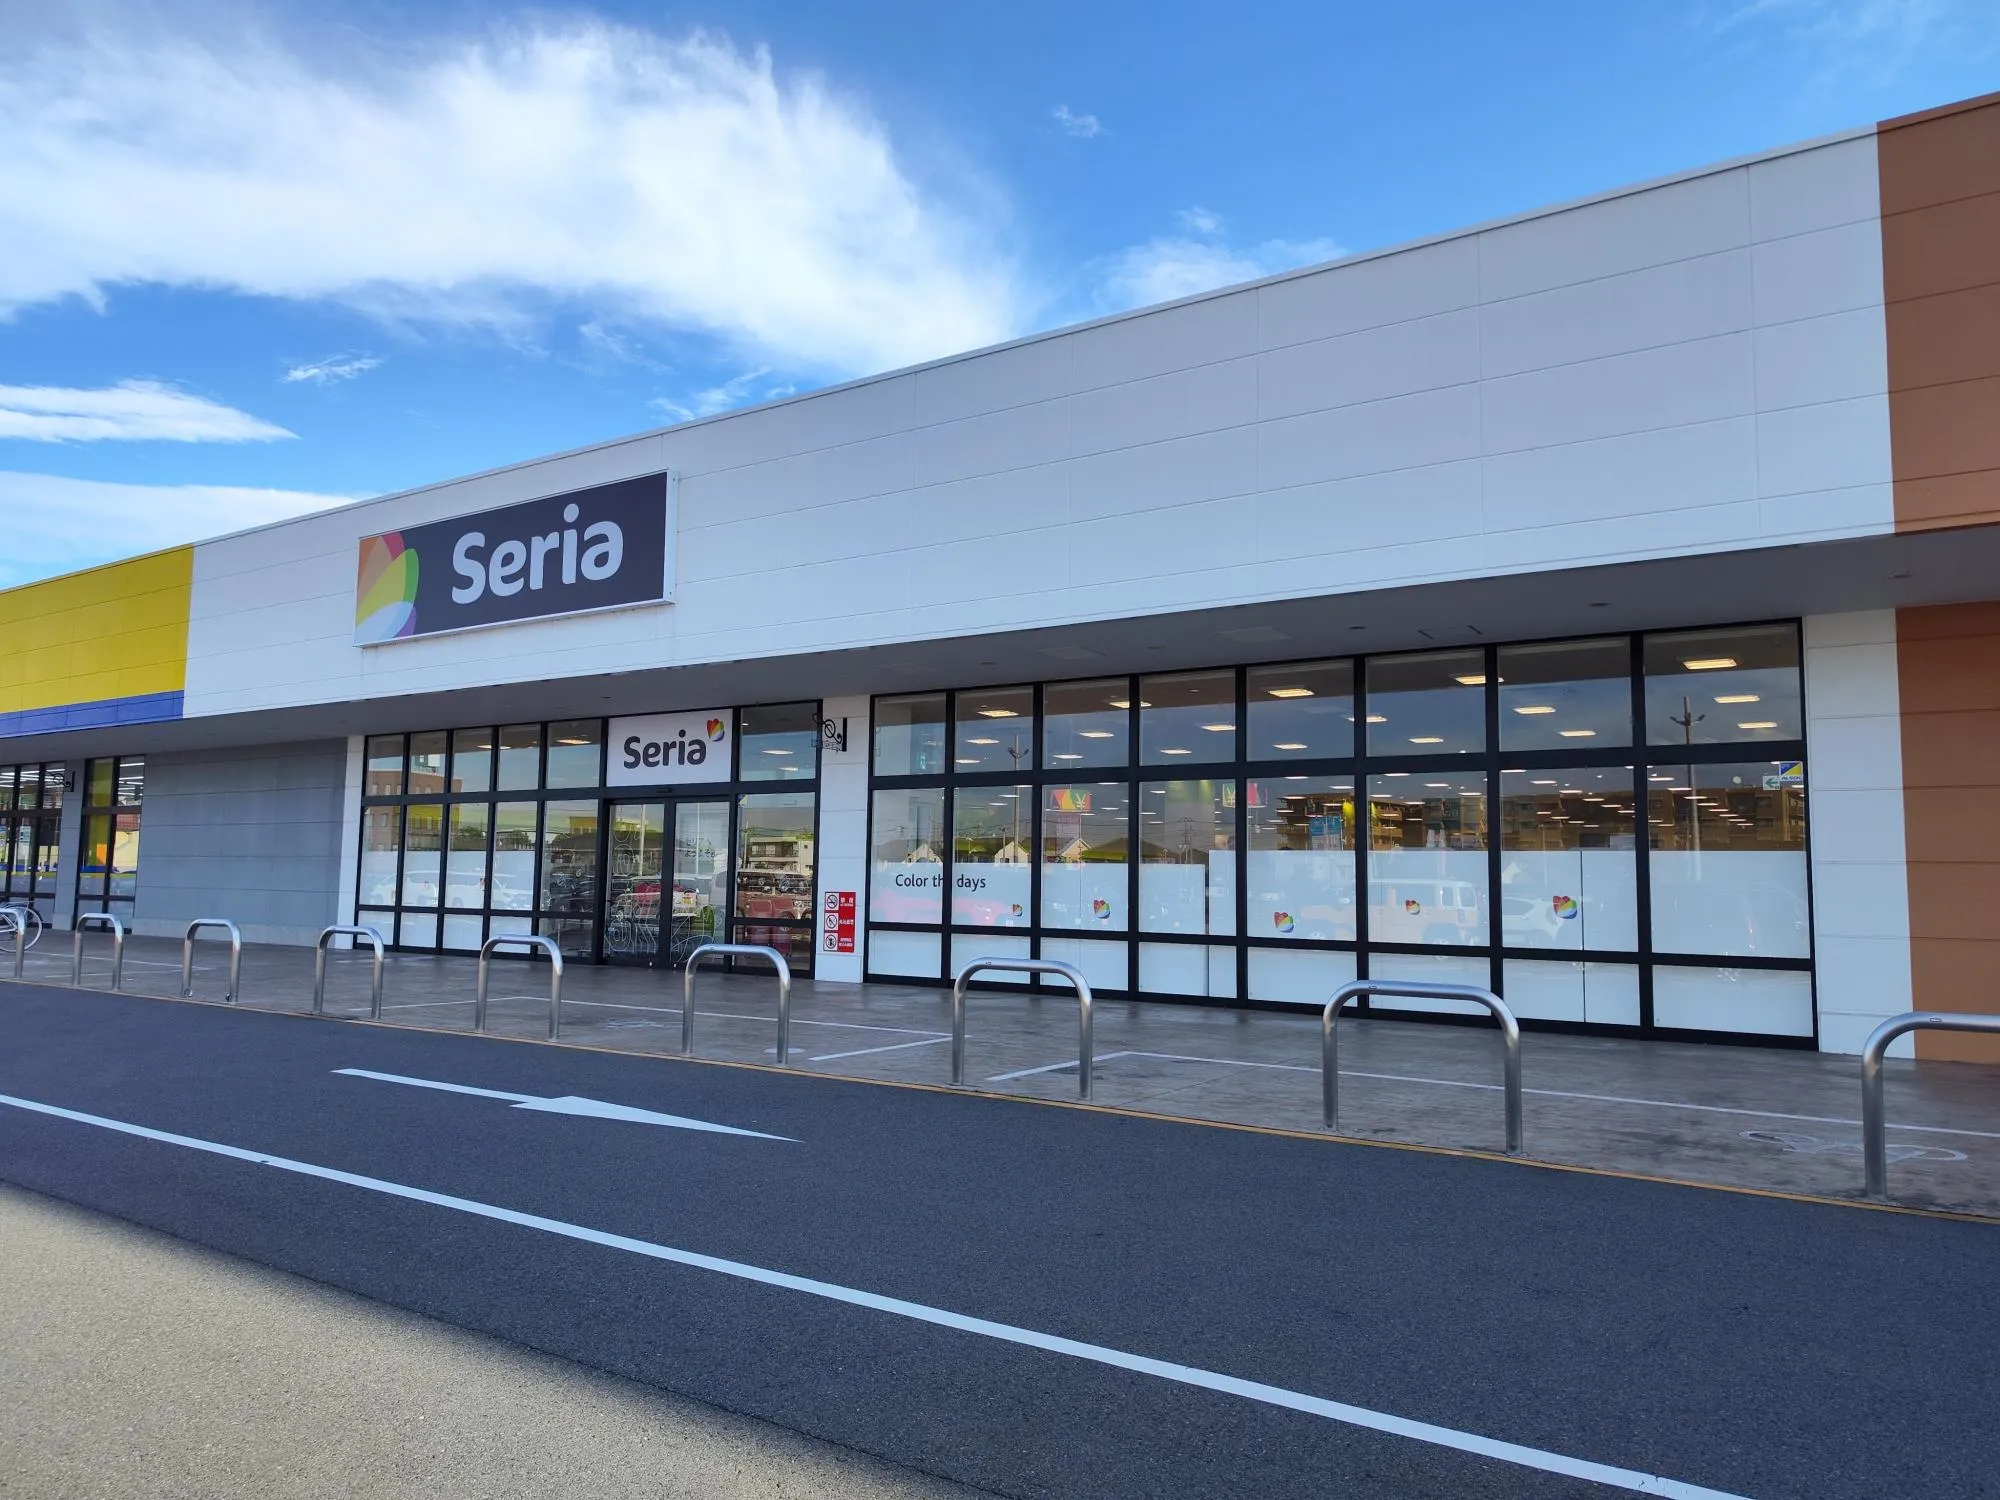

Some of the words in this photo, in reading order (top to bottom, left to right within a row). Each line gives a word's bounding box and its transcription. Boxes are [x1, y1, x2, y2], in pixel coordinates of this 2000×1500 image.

[452, 503, 624, 604] Seria
[623, 729, 707, 769] Seria
[895, 873, 929, 888] Color
[931, 873, 944, 888] th
[956, 873, 986, 892] days
